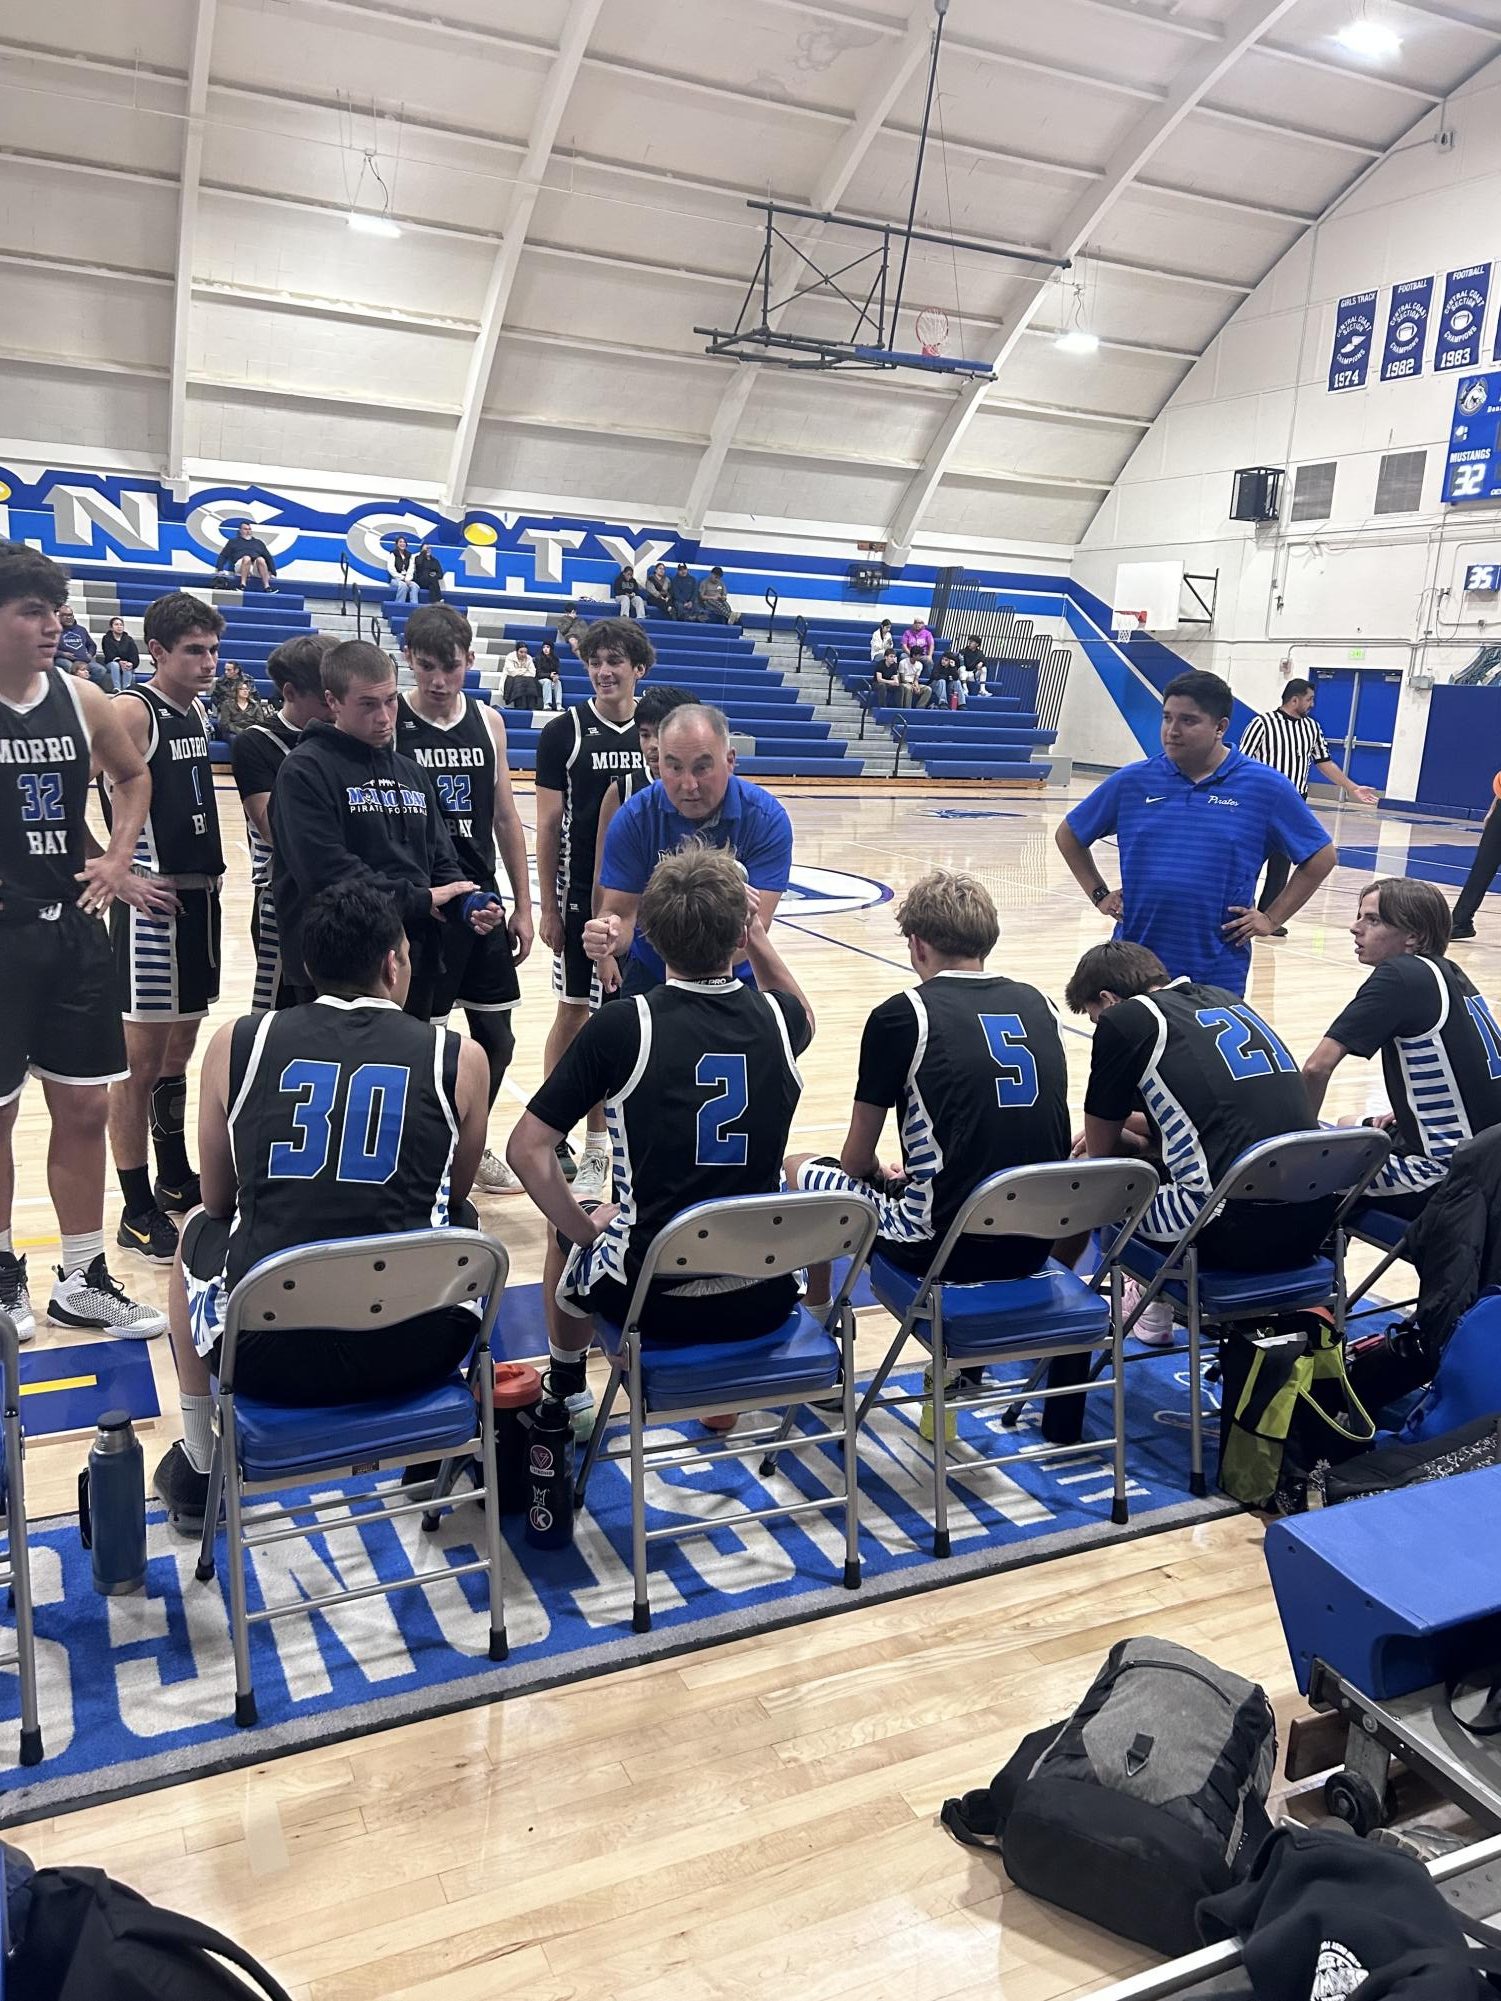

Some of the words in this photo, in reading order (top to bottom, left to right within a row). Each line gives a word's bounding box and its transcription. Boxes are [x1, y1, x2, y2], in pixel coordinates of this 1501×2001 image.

[1452, 266, 1485, 280] FOOTBALL
[1398, 280, 1428, 293] FOOTBALL
[1340, 297, 1357, 308] GIRLS
[1357, 292, 1377, 303] TRACK
[1451, 296, 1476, 311] SECTION
[1444, 325, 1478, 343] CHAMPIONS
[1385, 358, 1415, 378] 1982
[1440, 347, 1471, 369] 1983
[1333, 369, 1360, 388] 1974
[1449, 448, 1492, 464] MUSTANGS
[1451, 463, 1487, 497] 32
[1468, 567, 1495, 590] 35
[0, 736, 77, 764] MORRO
[414, 747, 485, 768] MORRO
[591, 752, 648, 770] MORR
[17, 772, 66, 822] 32
[400, 790, 427, 808] BAY
[437, 774, 473, 812] 22
[1207, 795, 1240, 807] Pirates
[350, 805, 384, 814] PIRATE
[26, 830, 68, 855] BAY
[1195, 1004, 1298, 1080] 21
[978, 1013, 1040, 1108] 5
[695, 1053, 749, 1166] 2
[267, 1059, 410, 1184] 30
